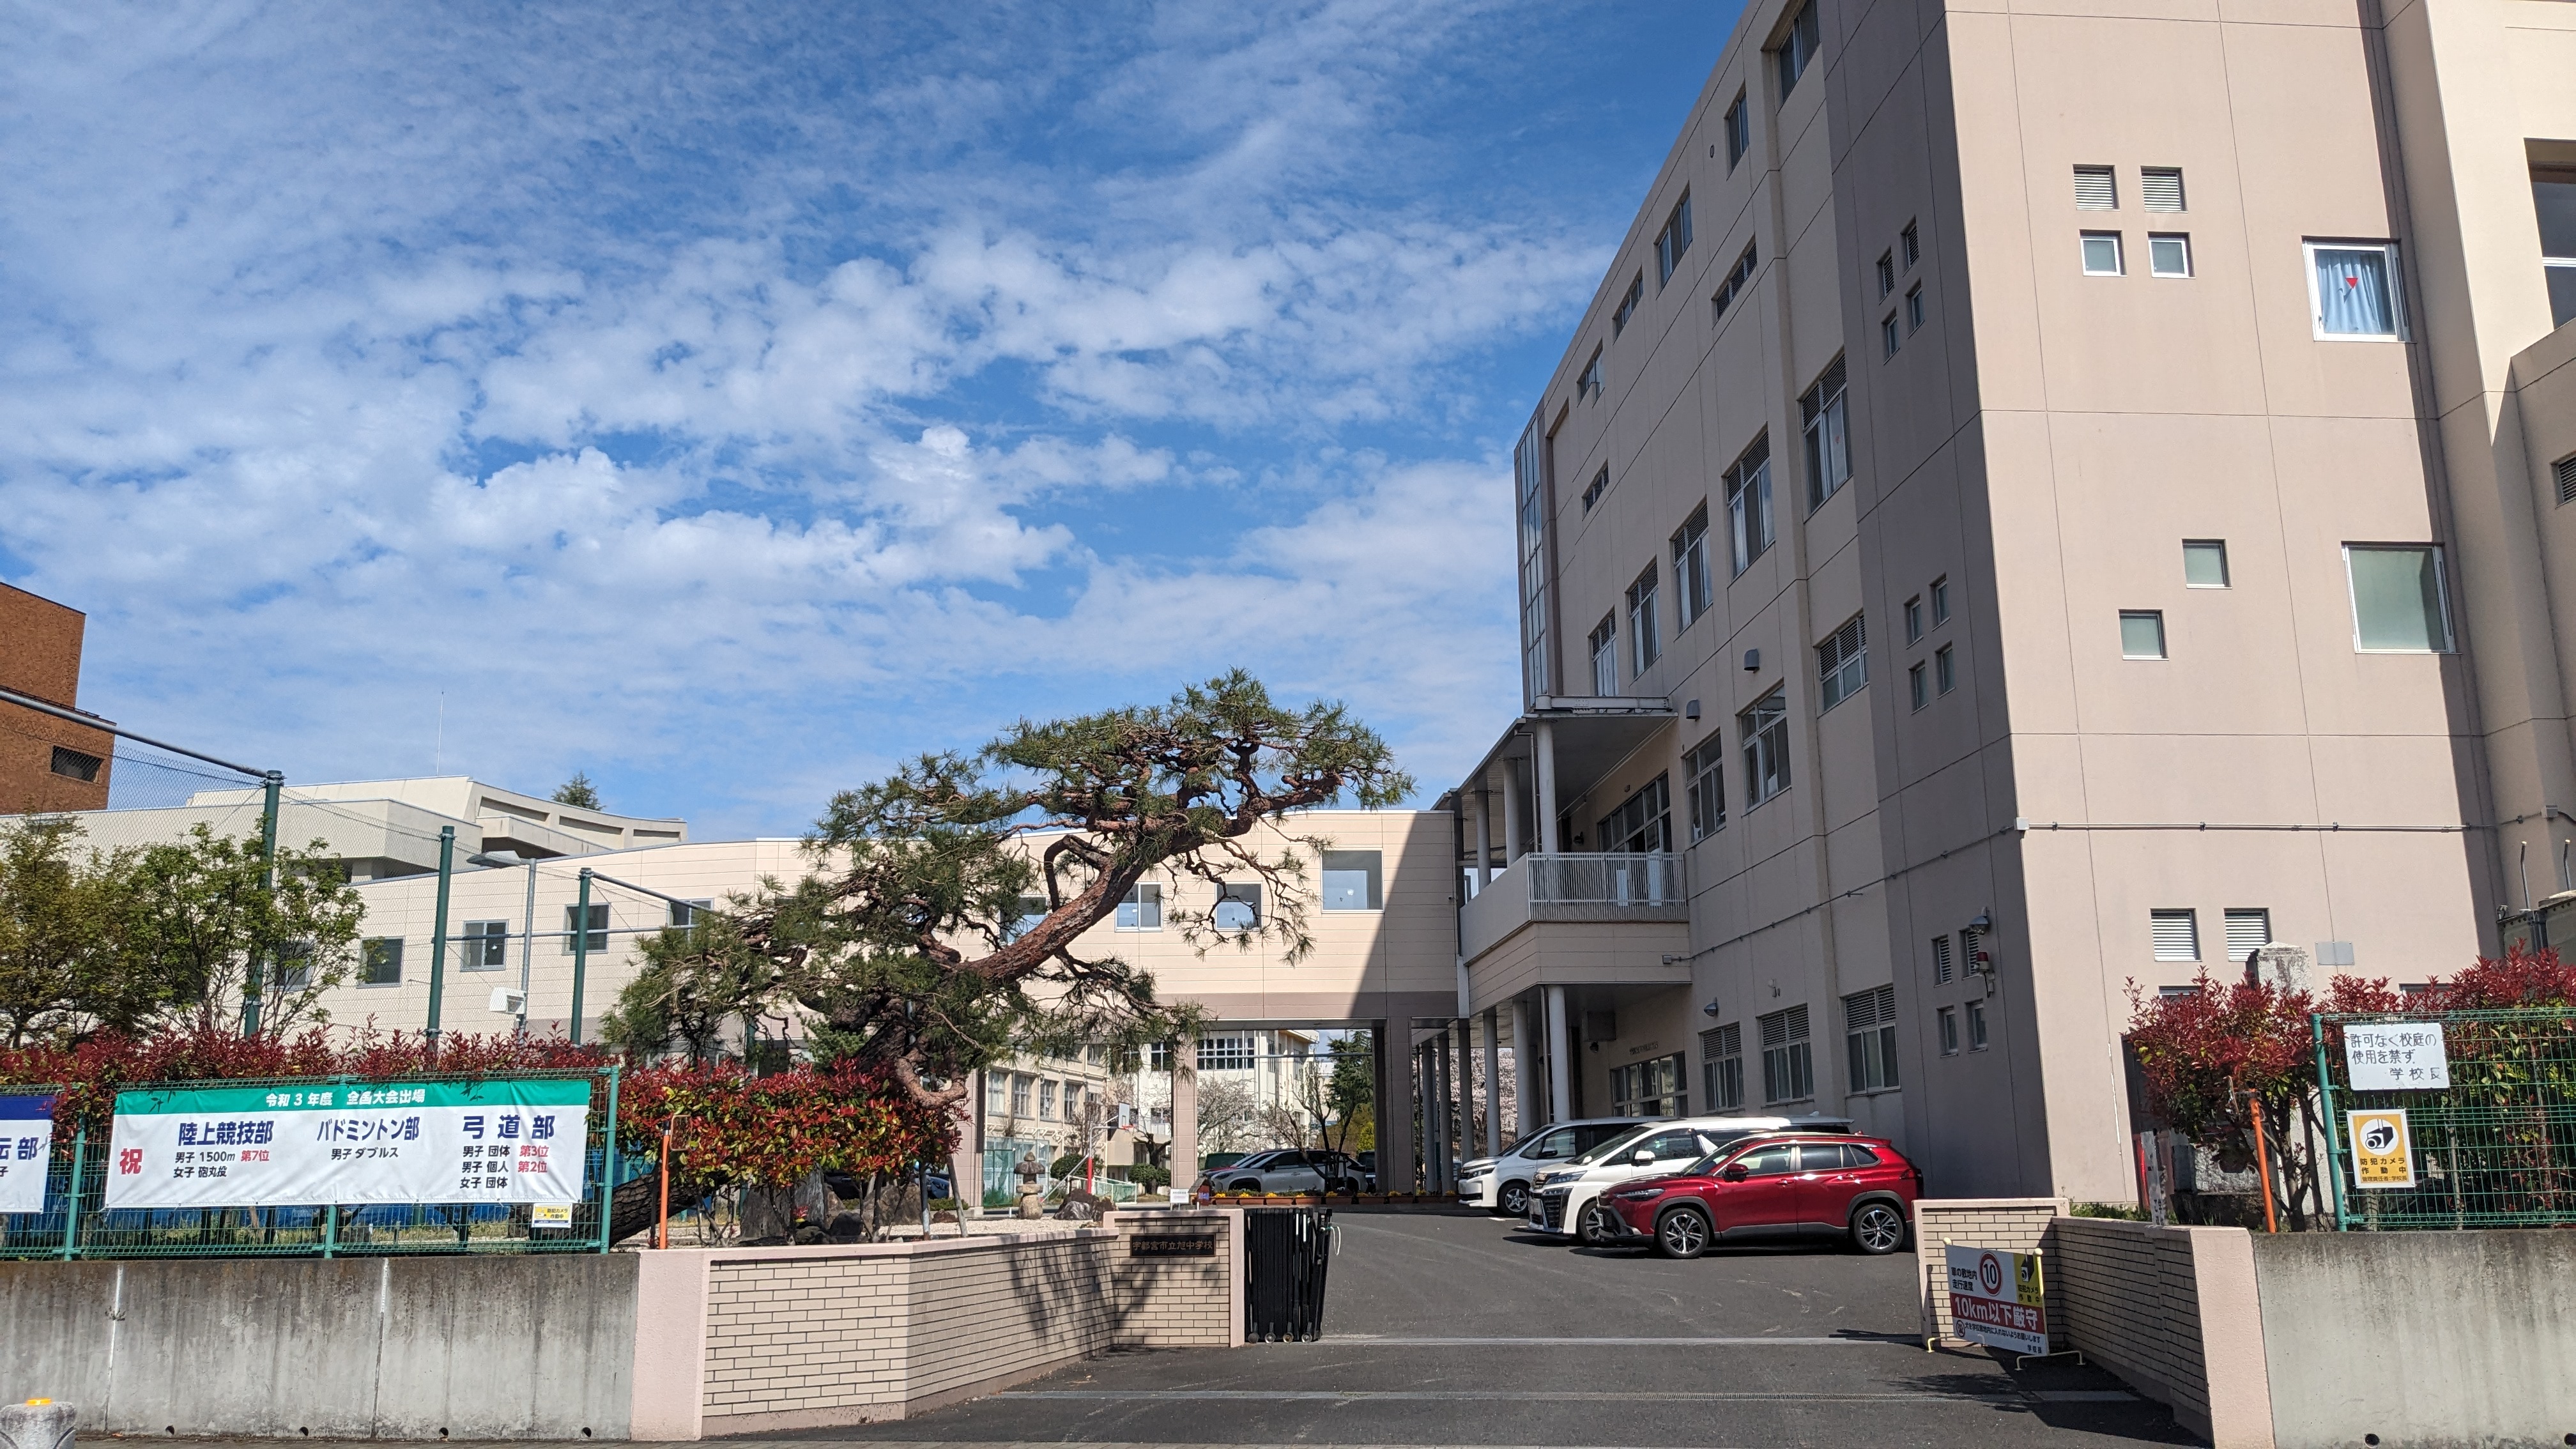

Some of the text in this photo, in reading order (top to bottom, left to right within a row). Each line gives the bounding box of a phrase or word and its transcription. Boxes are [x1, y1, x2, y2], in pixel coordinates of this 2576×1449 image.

[2350, 1032, 2437, 1048] 許可なく校庭の
[2389, 1067, 2441, 1080] 学校長
[347, 1088, 425, 1105] 全国大会出場
[178, 1120, 274, 1146] 陸上競技部
[317, 1116, 420, 1142] バドミントン部
[462, 1114, 555, 1140] 弓道部
[175, 1149, 270, 1163] 男子 1500m 第7位
[331, 1146, 399, 1160] 男子 ダブルス
[463, 1145, 549, 1158] 男子 団体 第3位
[119, 1149, 142, 1175] 祝
[462, 1160, 548, 1174] 男子 個人 第2位
[2359, 1158, 2405, 1166] 防犯カメラ
[173, 1165, 227, 1178] 女子 砲丸投
[2361, 1166, 2407, 1175] 作動中
[459, 1176, 509, 1190] 女子 団体
[1984, 1263, 1997, 1285] 10
[1954, 1296, 2038, 1331] 10km以下厳守
